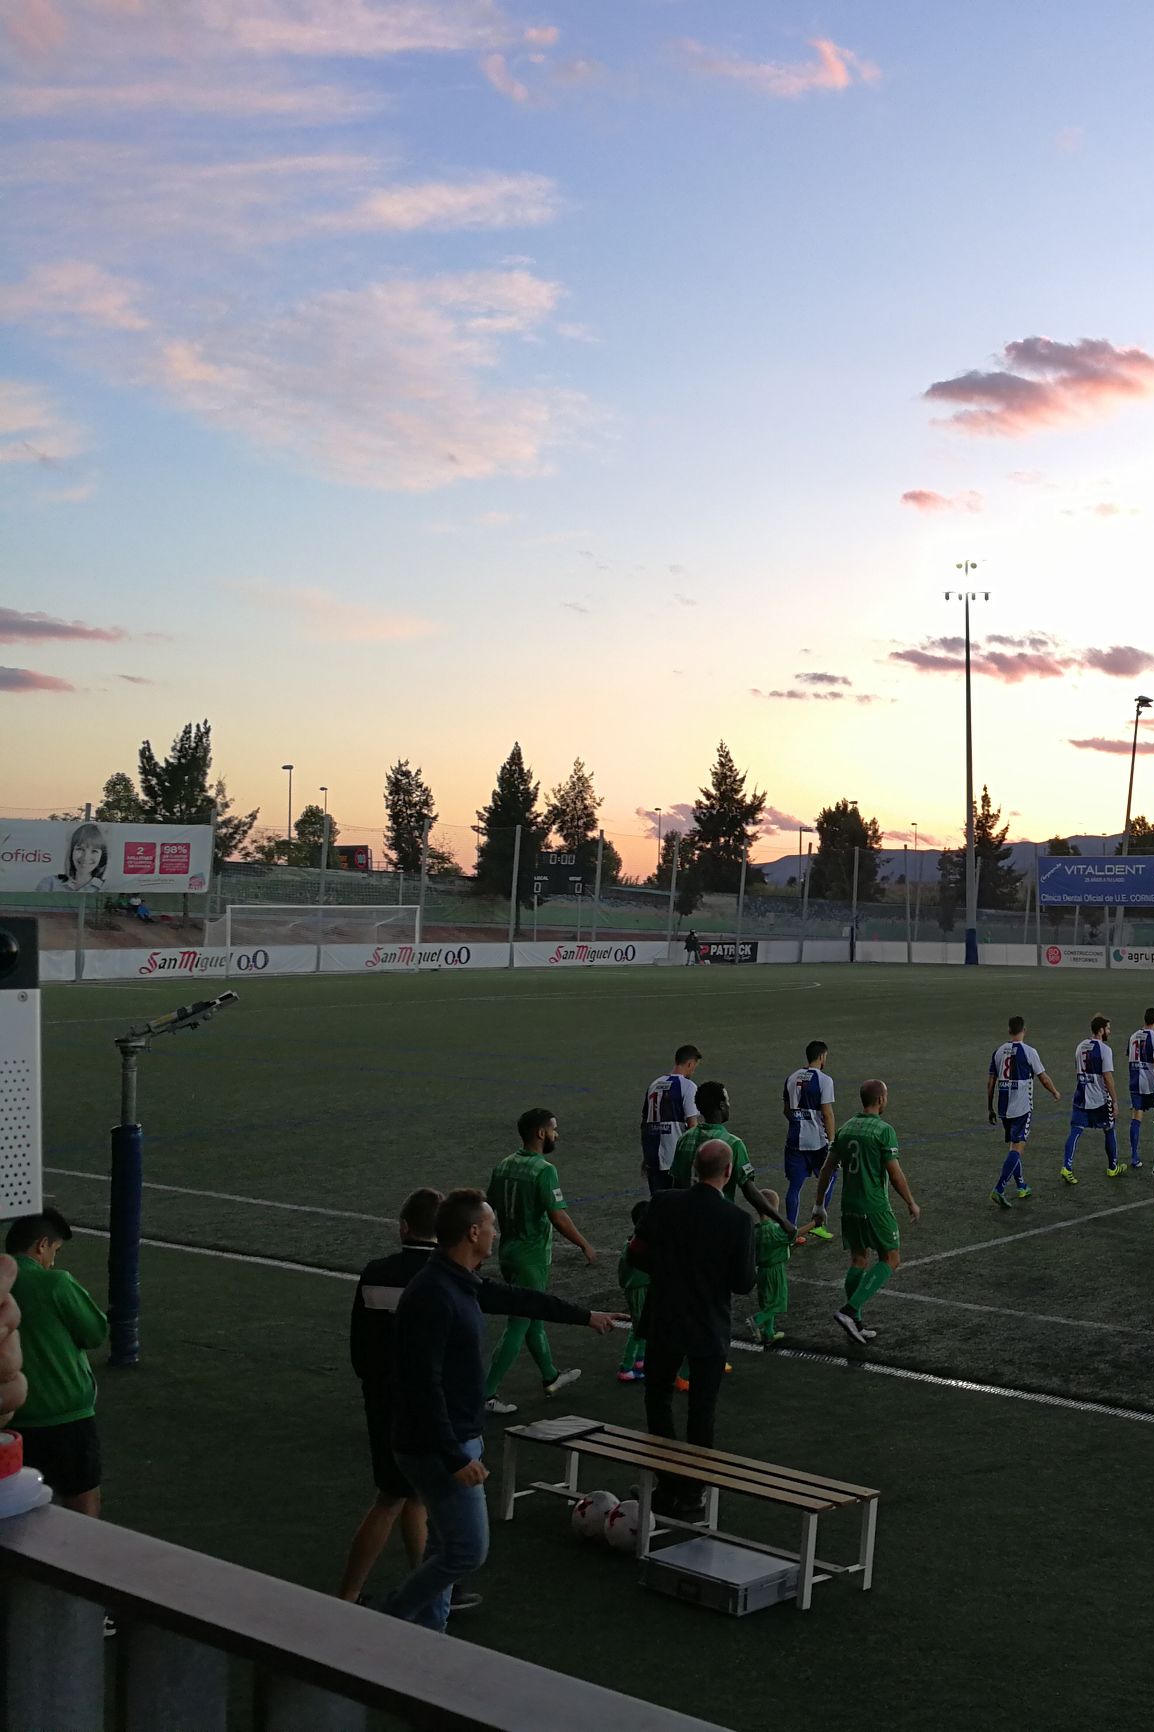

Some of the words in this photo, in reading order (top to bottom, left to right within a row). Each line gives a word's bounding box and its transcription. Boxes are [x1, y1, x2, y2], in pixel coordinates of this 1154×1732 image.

[136, 847, 144, 855] 2
[1064, 865, 1147, 875] VITALDENT
[710, 944, 752, 956] PATRCK
[848, 1139, 860, 1174] 3
